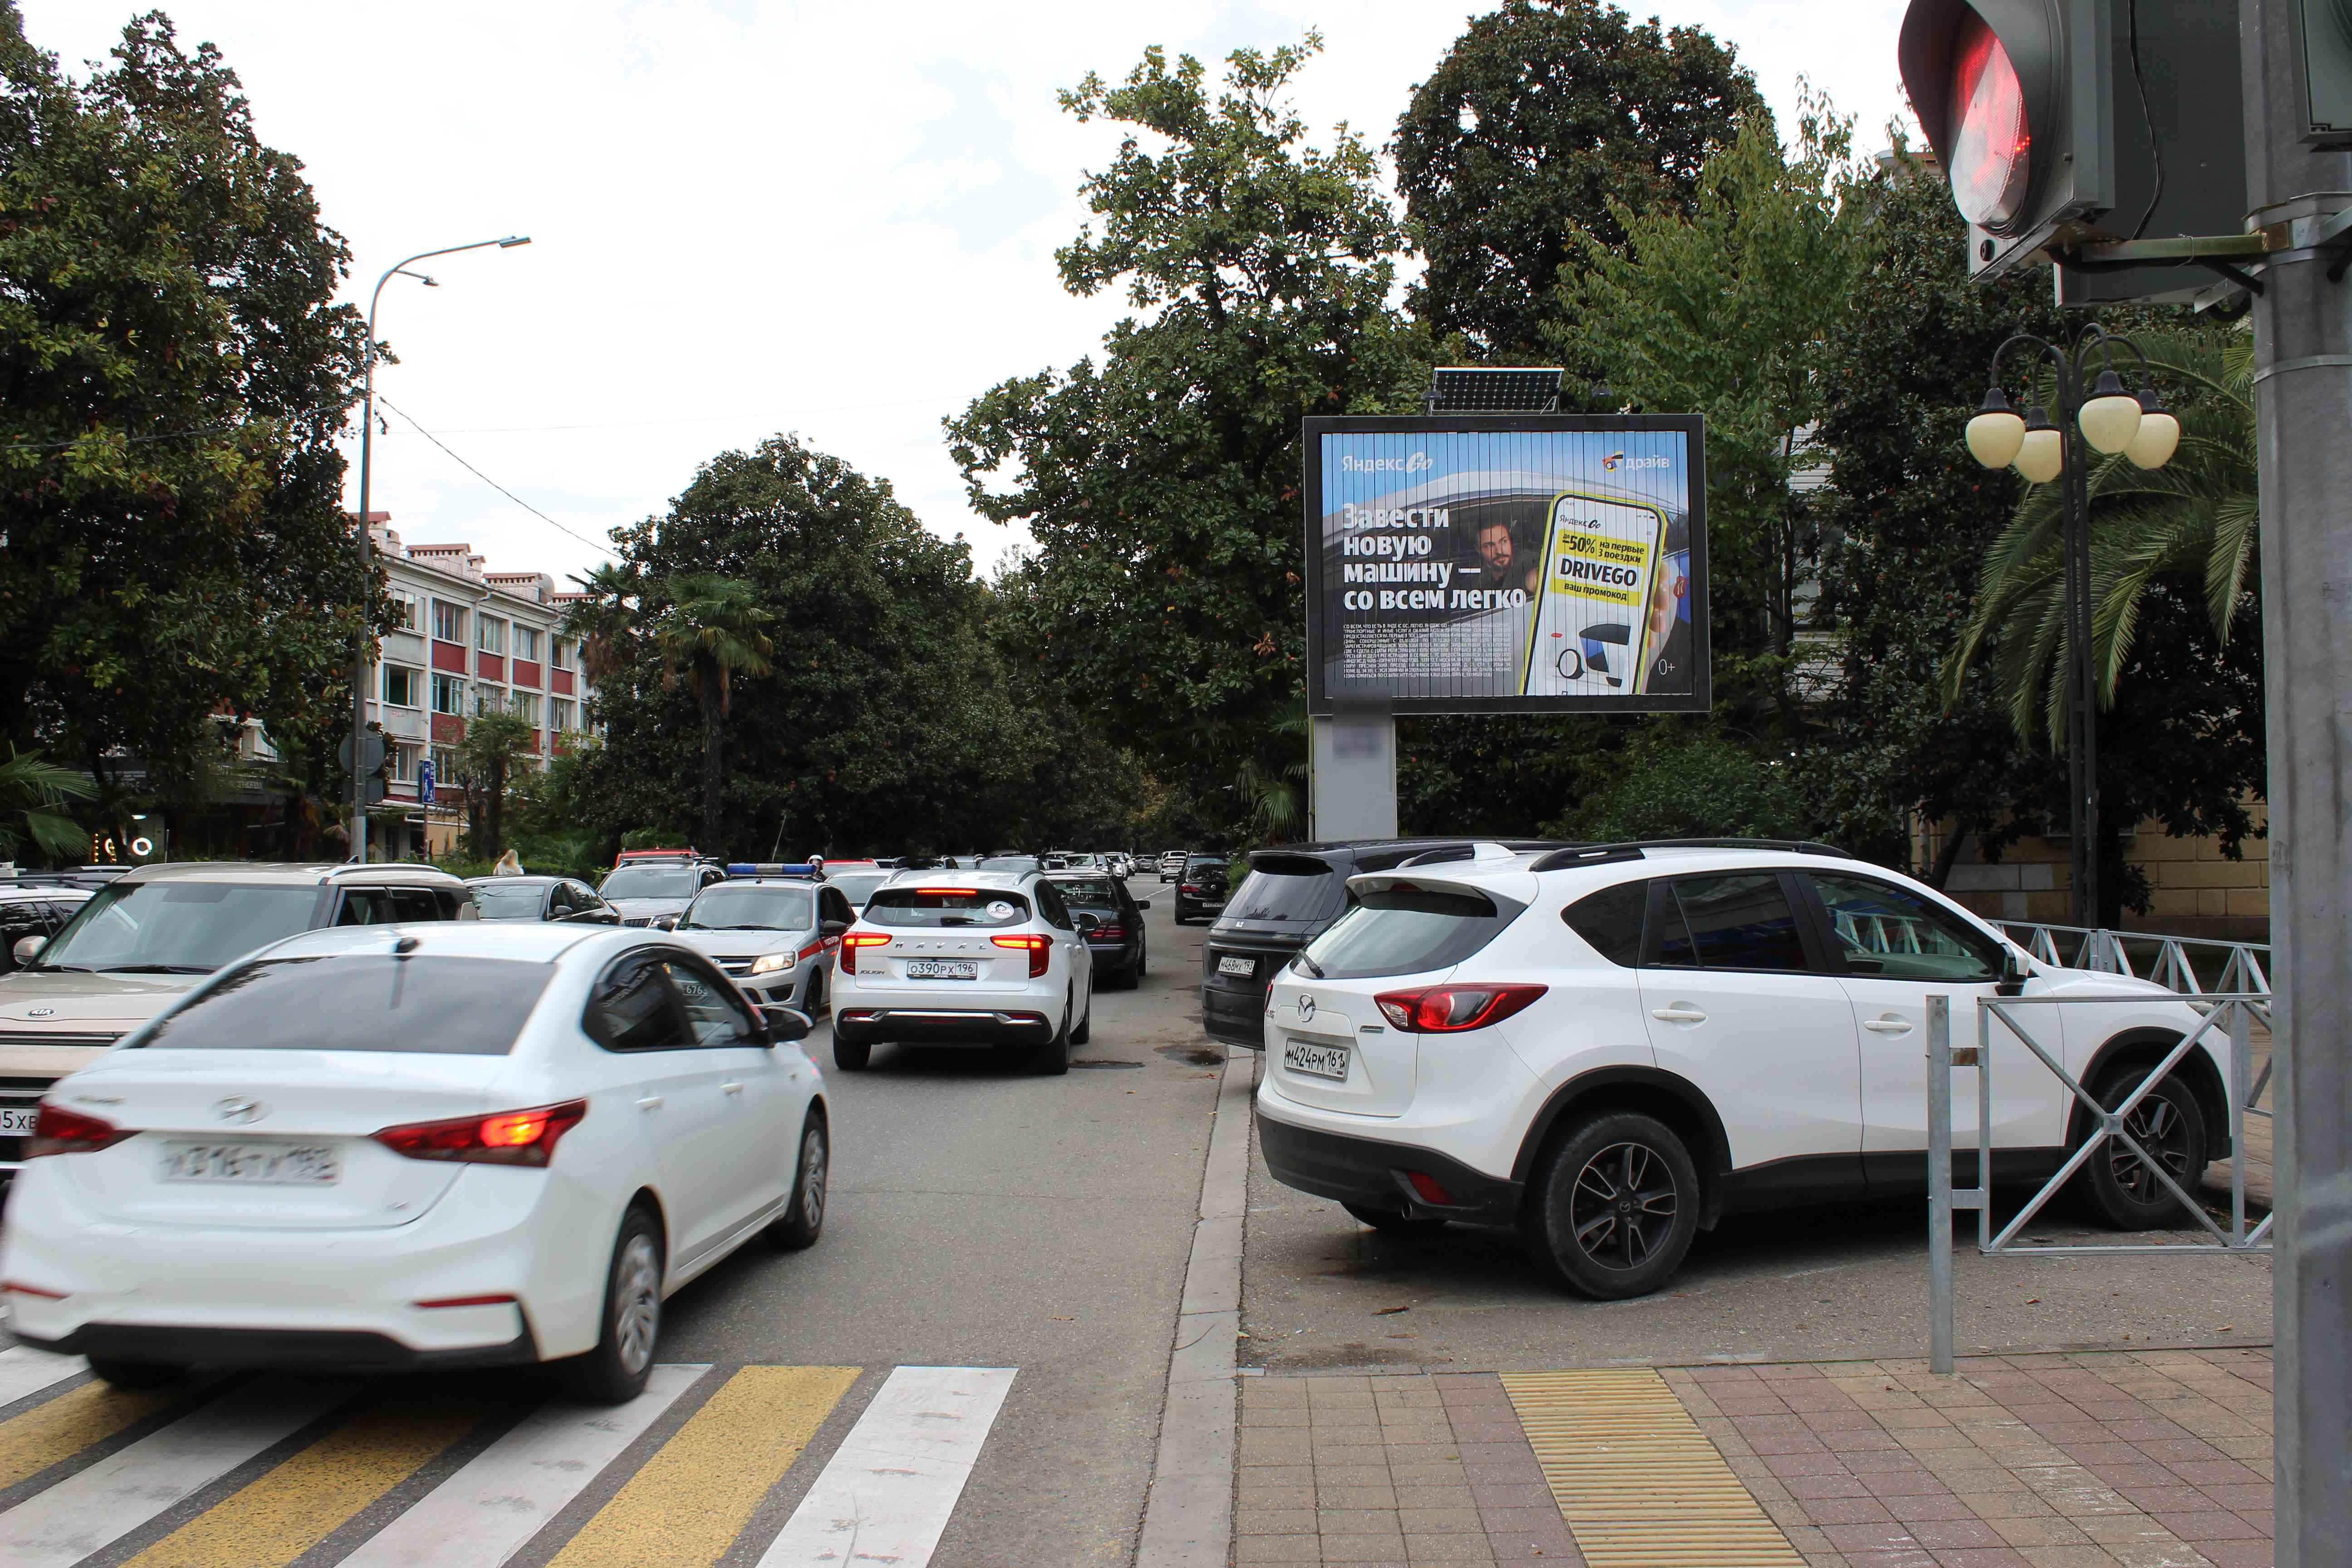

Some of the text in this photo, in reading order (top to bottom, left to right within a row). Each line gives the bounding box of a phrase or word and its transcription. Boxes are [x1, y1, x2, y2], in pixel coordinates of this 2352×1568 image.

[1342, 451, 1434, 474] Яндекс Go
[1625, 454, 1670, 470] драйв
[1343, 502, 1449, 529] Завести
[1559, 514, 1601, 529] Яндекс Go
[1343, 534, 1432, 562] новую
[1598, 548, 1642, 564] 3 поездки
[1599, 541, 1645, 555] на первые
[1343, 562, 1453, 589] машину
[1560, 558, 1637, 587] DRIVEGO
[1343, 588, 1527, 610] со всем легко
[1564, 583, 1627, 602] ваш промокод
[1658, 659, 1676, 675] 0+
[911, 963, 974, 974] О390РХ 196
[1220, 959, 1254, 972] М468МХ 193
[1285, 1046, 1325, 1071] М424РМ
